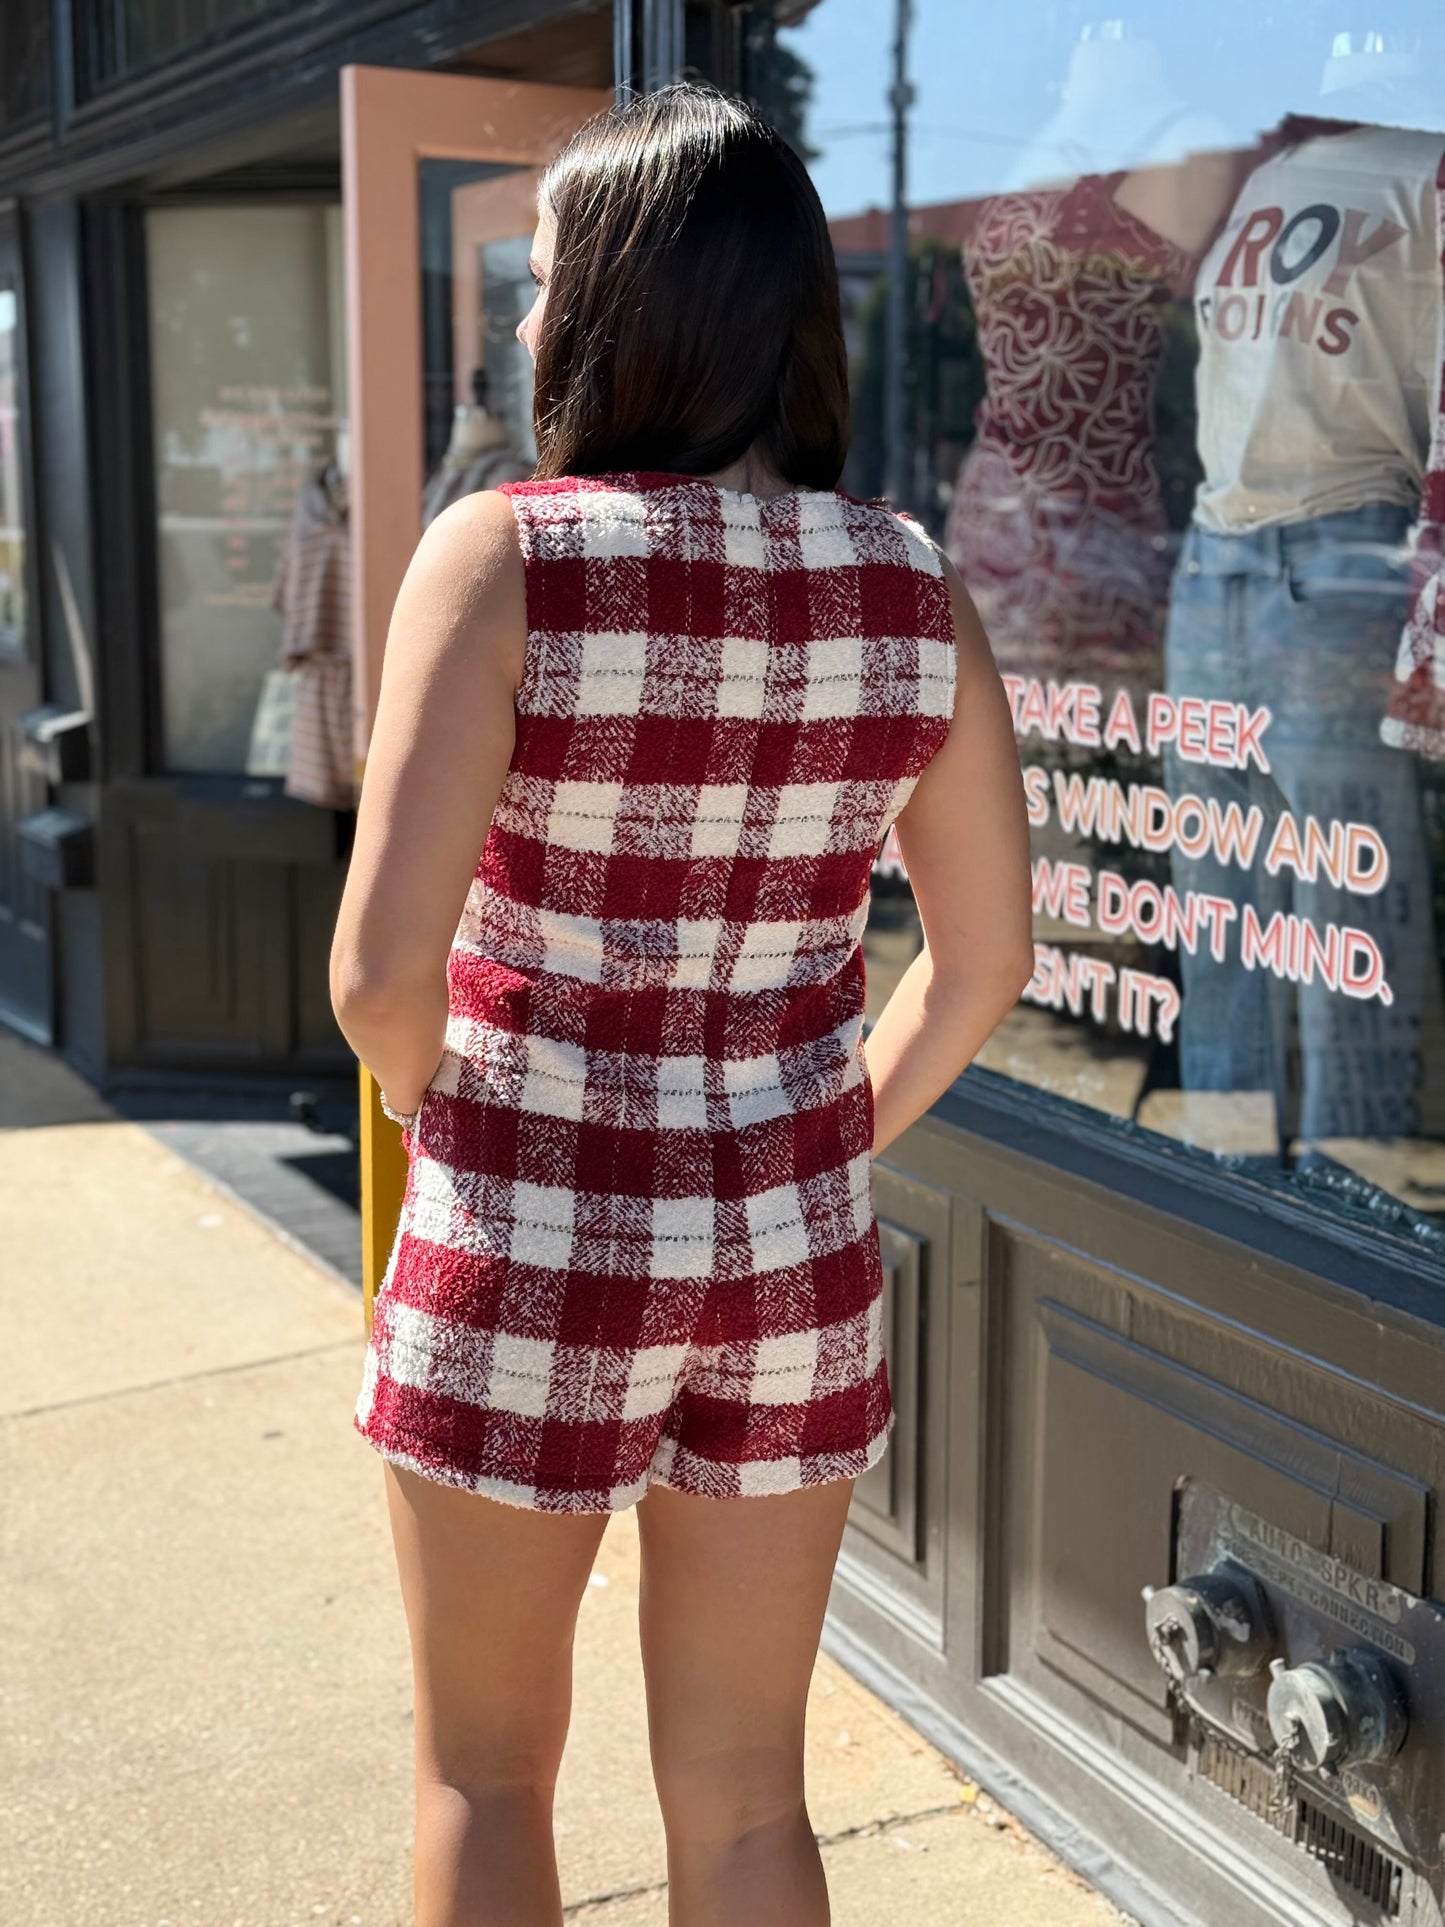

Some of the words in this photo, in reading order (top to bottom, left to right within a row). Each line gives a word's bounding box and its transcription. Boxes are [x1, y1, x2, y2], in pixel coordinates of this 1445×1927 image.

[1001, 674, 1102, 746] TAKE
[1104, 687, 1141, 755] A
[1147, 692, 1272, 776] PEEK
[1053, 769, 1263, 870] WINDOW
[1265, 811, 1388, 894] AND
[1031, 856, 1092, 926] WE
[1097, 869, 1237, 964] DON'T
[1022, 942, 1116, 1021] SN'T
[1119, 967, 1181, 1044] IT?
